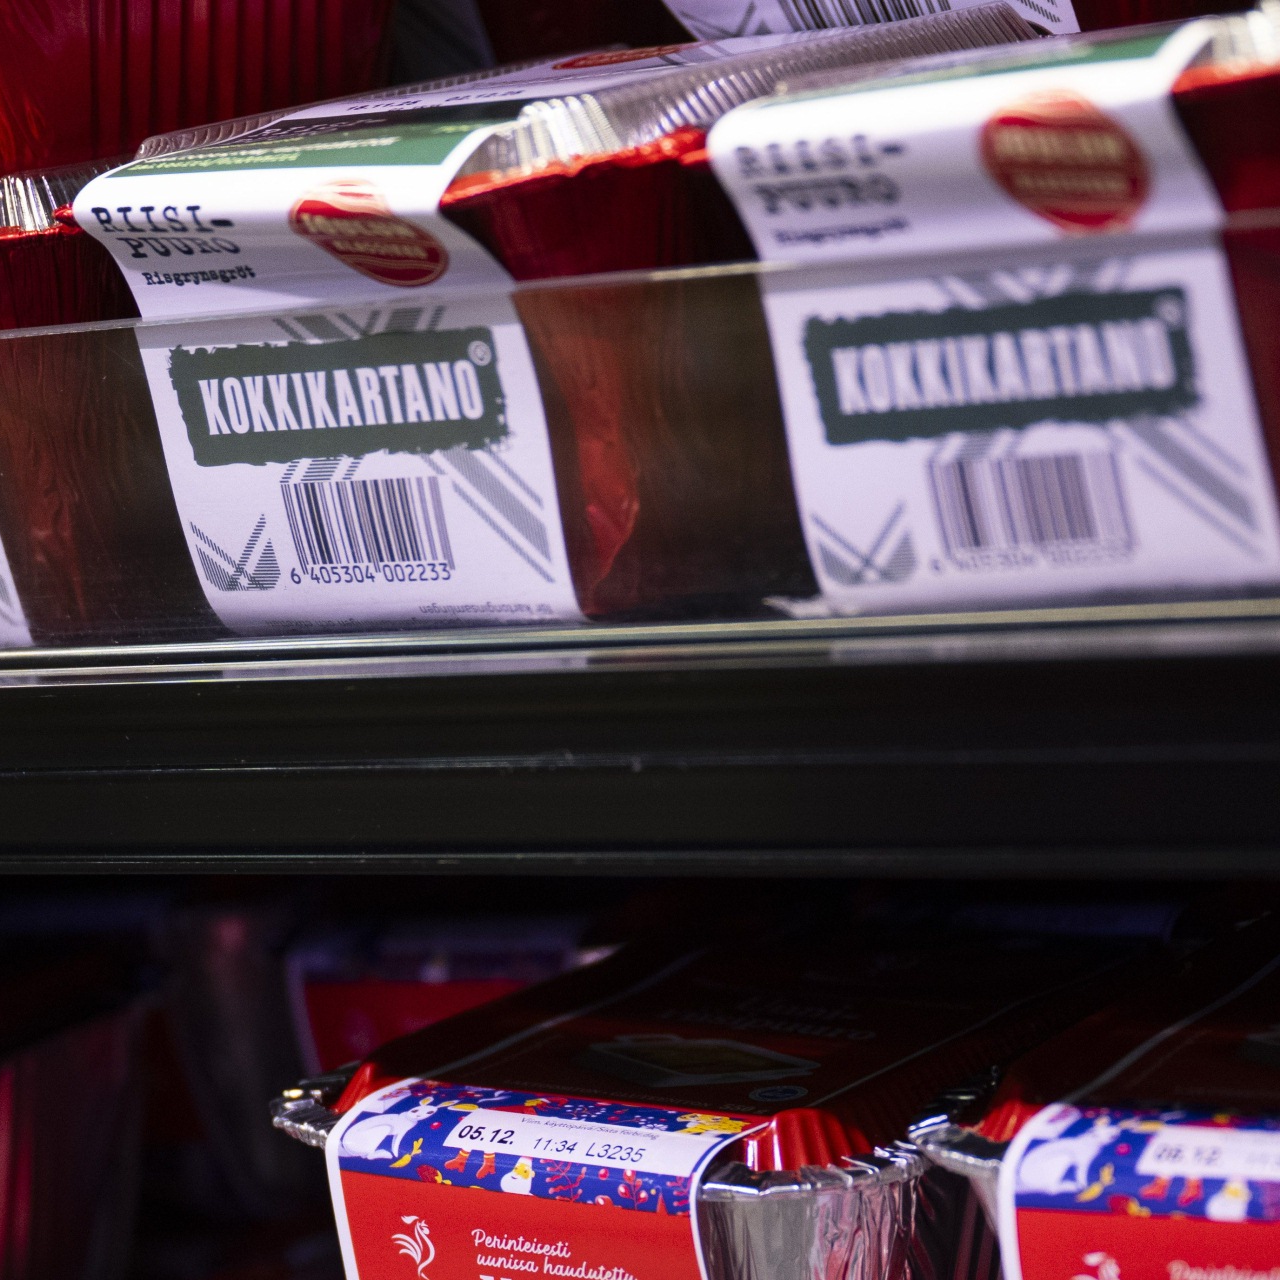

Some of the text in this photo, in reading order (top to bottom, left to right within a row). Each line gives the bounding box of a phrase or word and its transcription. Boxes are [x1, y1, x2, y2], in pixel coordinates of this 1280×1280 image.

[91, 205, 234, 233] RIISI-
[116, 237, 241, 258] PUURO
[142, 265, 256, 286] Risgrynsgröt
[198, 360, 484, 435] KOKKIKARTANO
[290, 562, 452, 585] 6 405304 002233
[458, 1125, 647, 1163] 05.12. 11:34 L3235
[471, 1228, 571, 1259] Perinteisesti
[477, 1253, 539, 1273] uunissa
